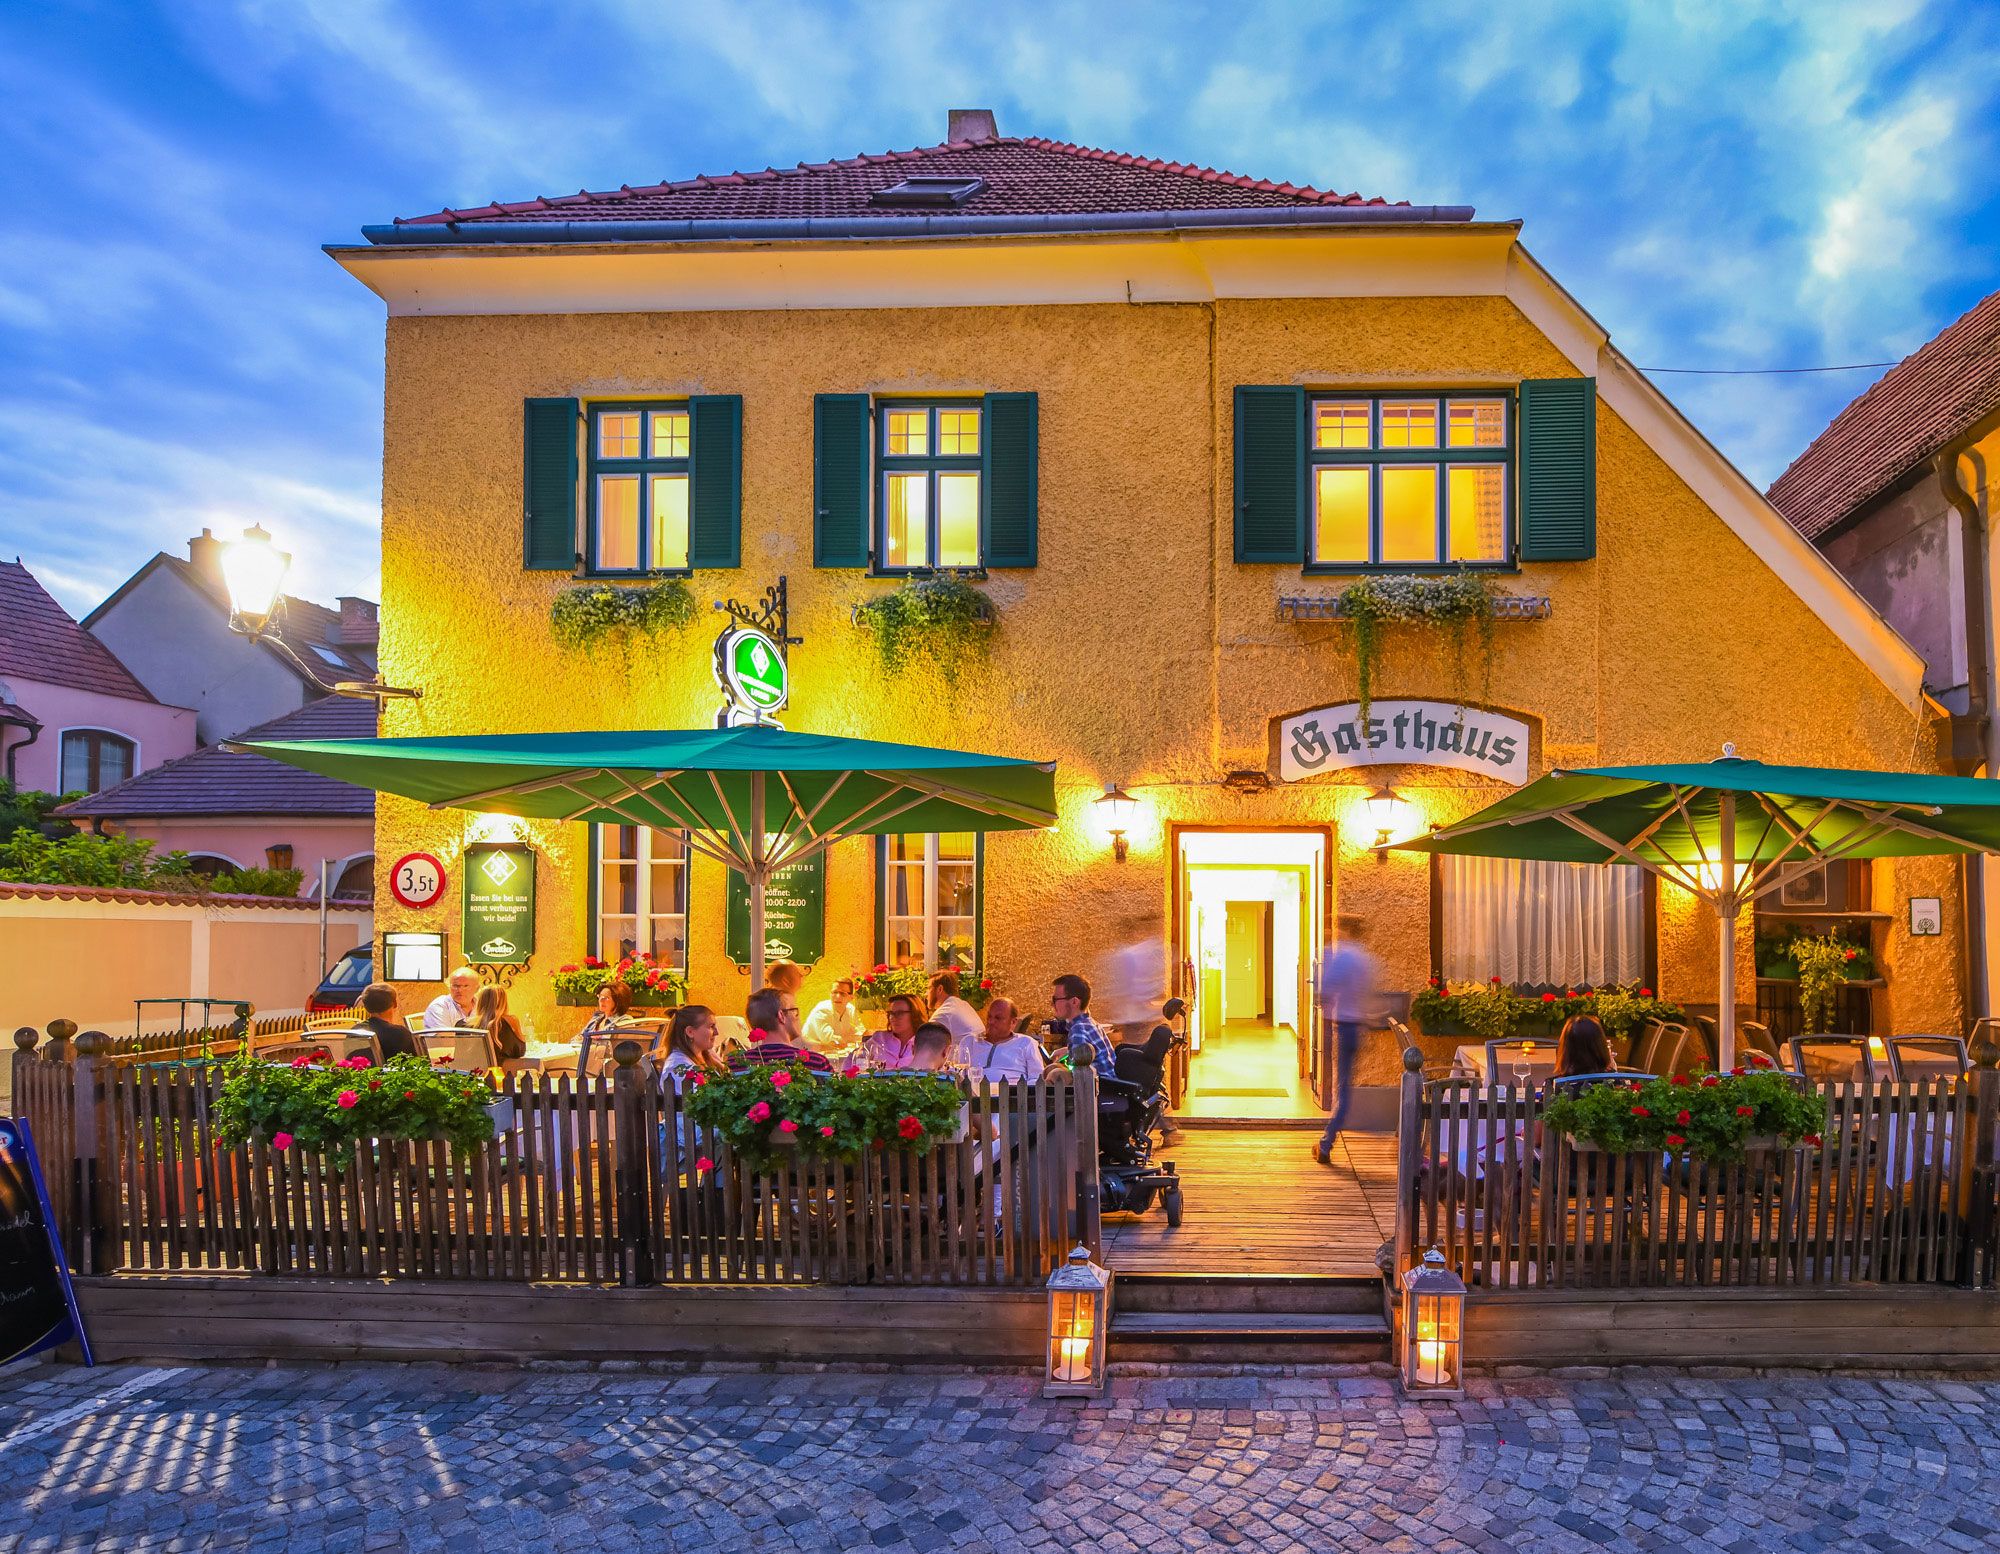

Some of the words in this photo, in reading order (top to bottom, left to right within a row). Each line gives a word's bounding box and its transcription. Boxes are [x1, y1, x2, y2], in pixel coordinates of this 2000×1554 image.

[1290, 708, 1519, 770] Gasthaus
[401, 867, 434, 895] 3,5t
[765, 888, 790, 896] eöffnet:
[470, 893, 490, 902] Essen
[491, 893, 502, 902] Sie
[503, 893, 514, 902] bei
[489, 904, 528, 914] verhungern
[483, 914, 495, 922] wir
[496, 914, 517, 922] beide!
